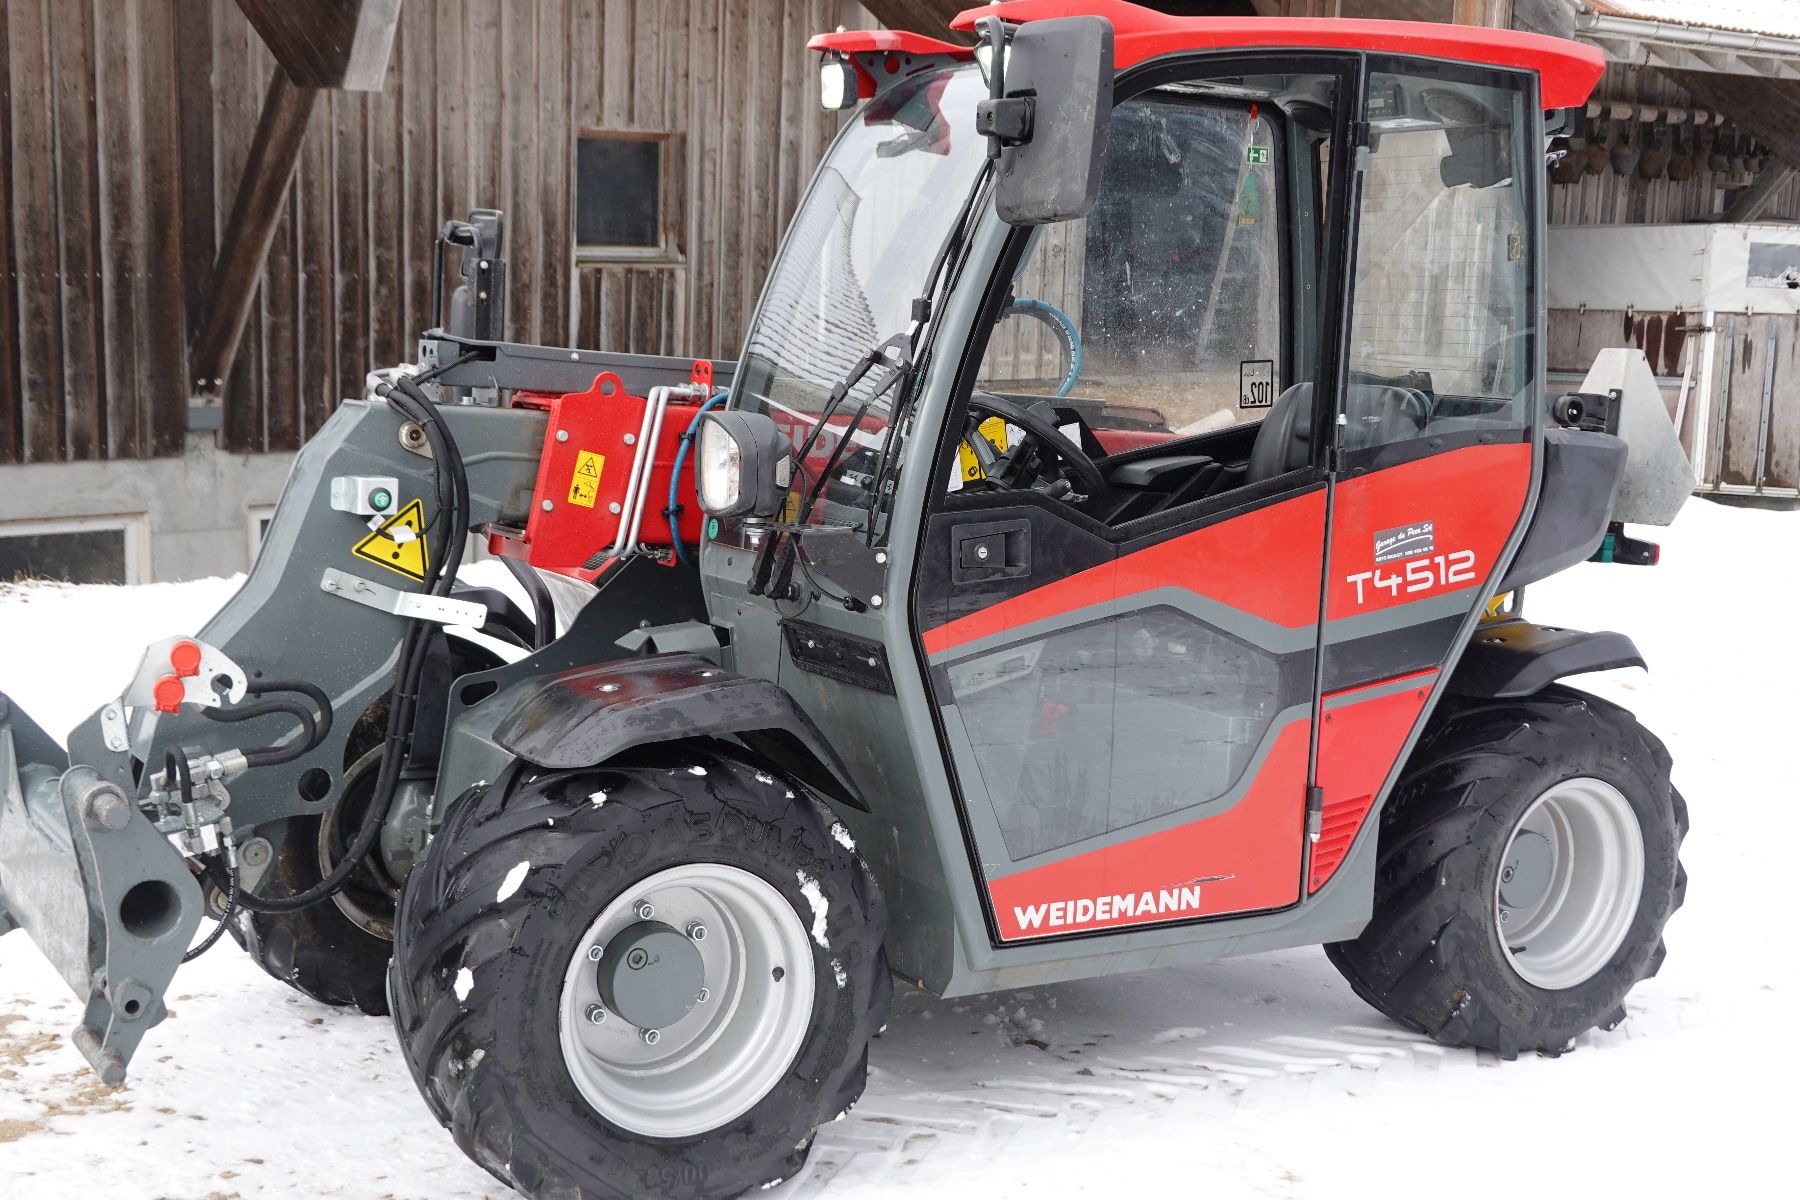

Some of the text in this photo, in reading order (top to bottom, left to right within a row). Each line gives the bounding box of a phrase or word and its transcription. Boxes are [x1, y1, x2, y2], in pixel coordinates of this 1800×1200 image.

[1422, 523, 1433, 533] SA
[1346, 549, 1476, 605] T4512
[1013, 885, 1200, 930] WEIDEMANN
